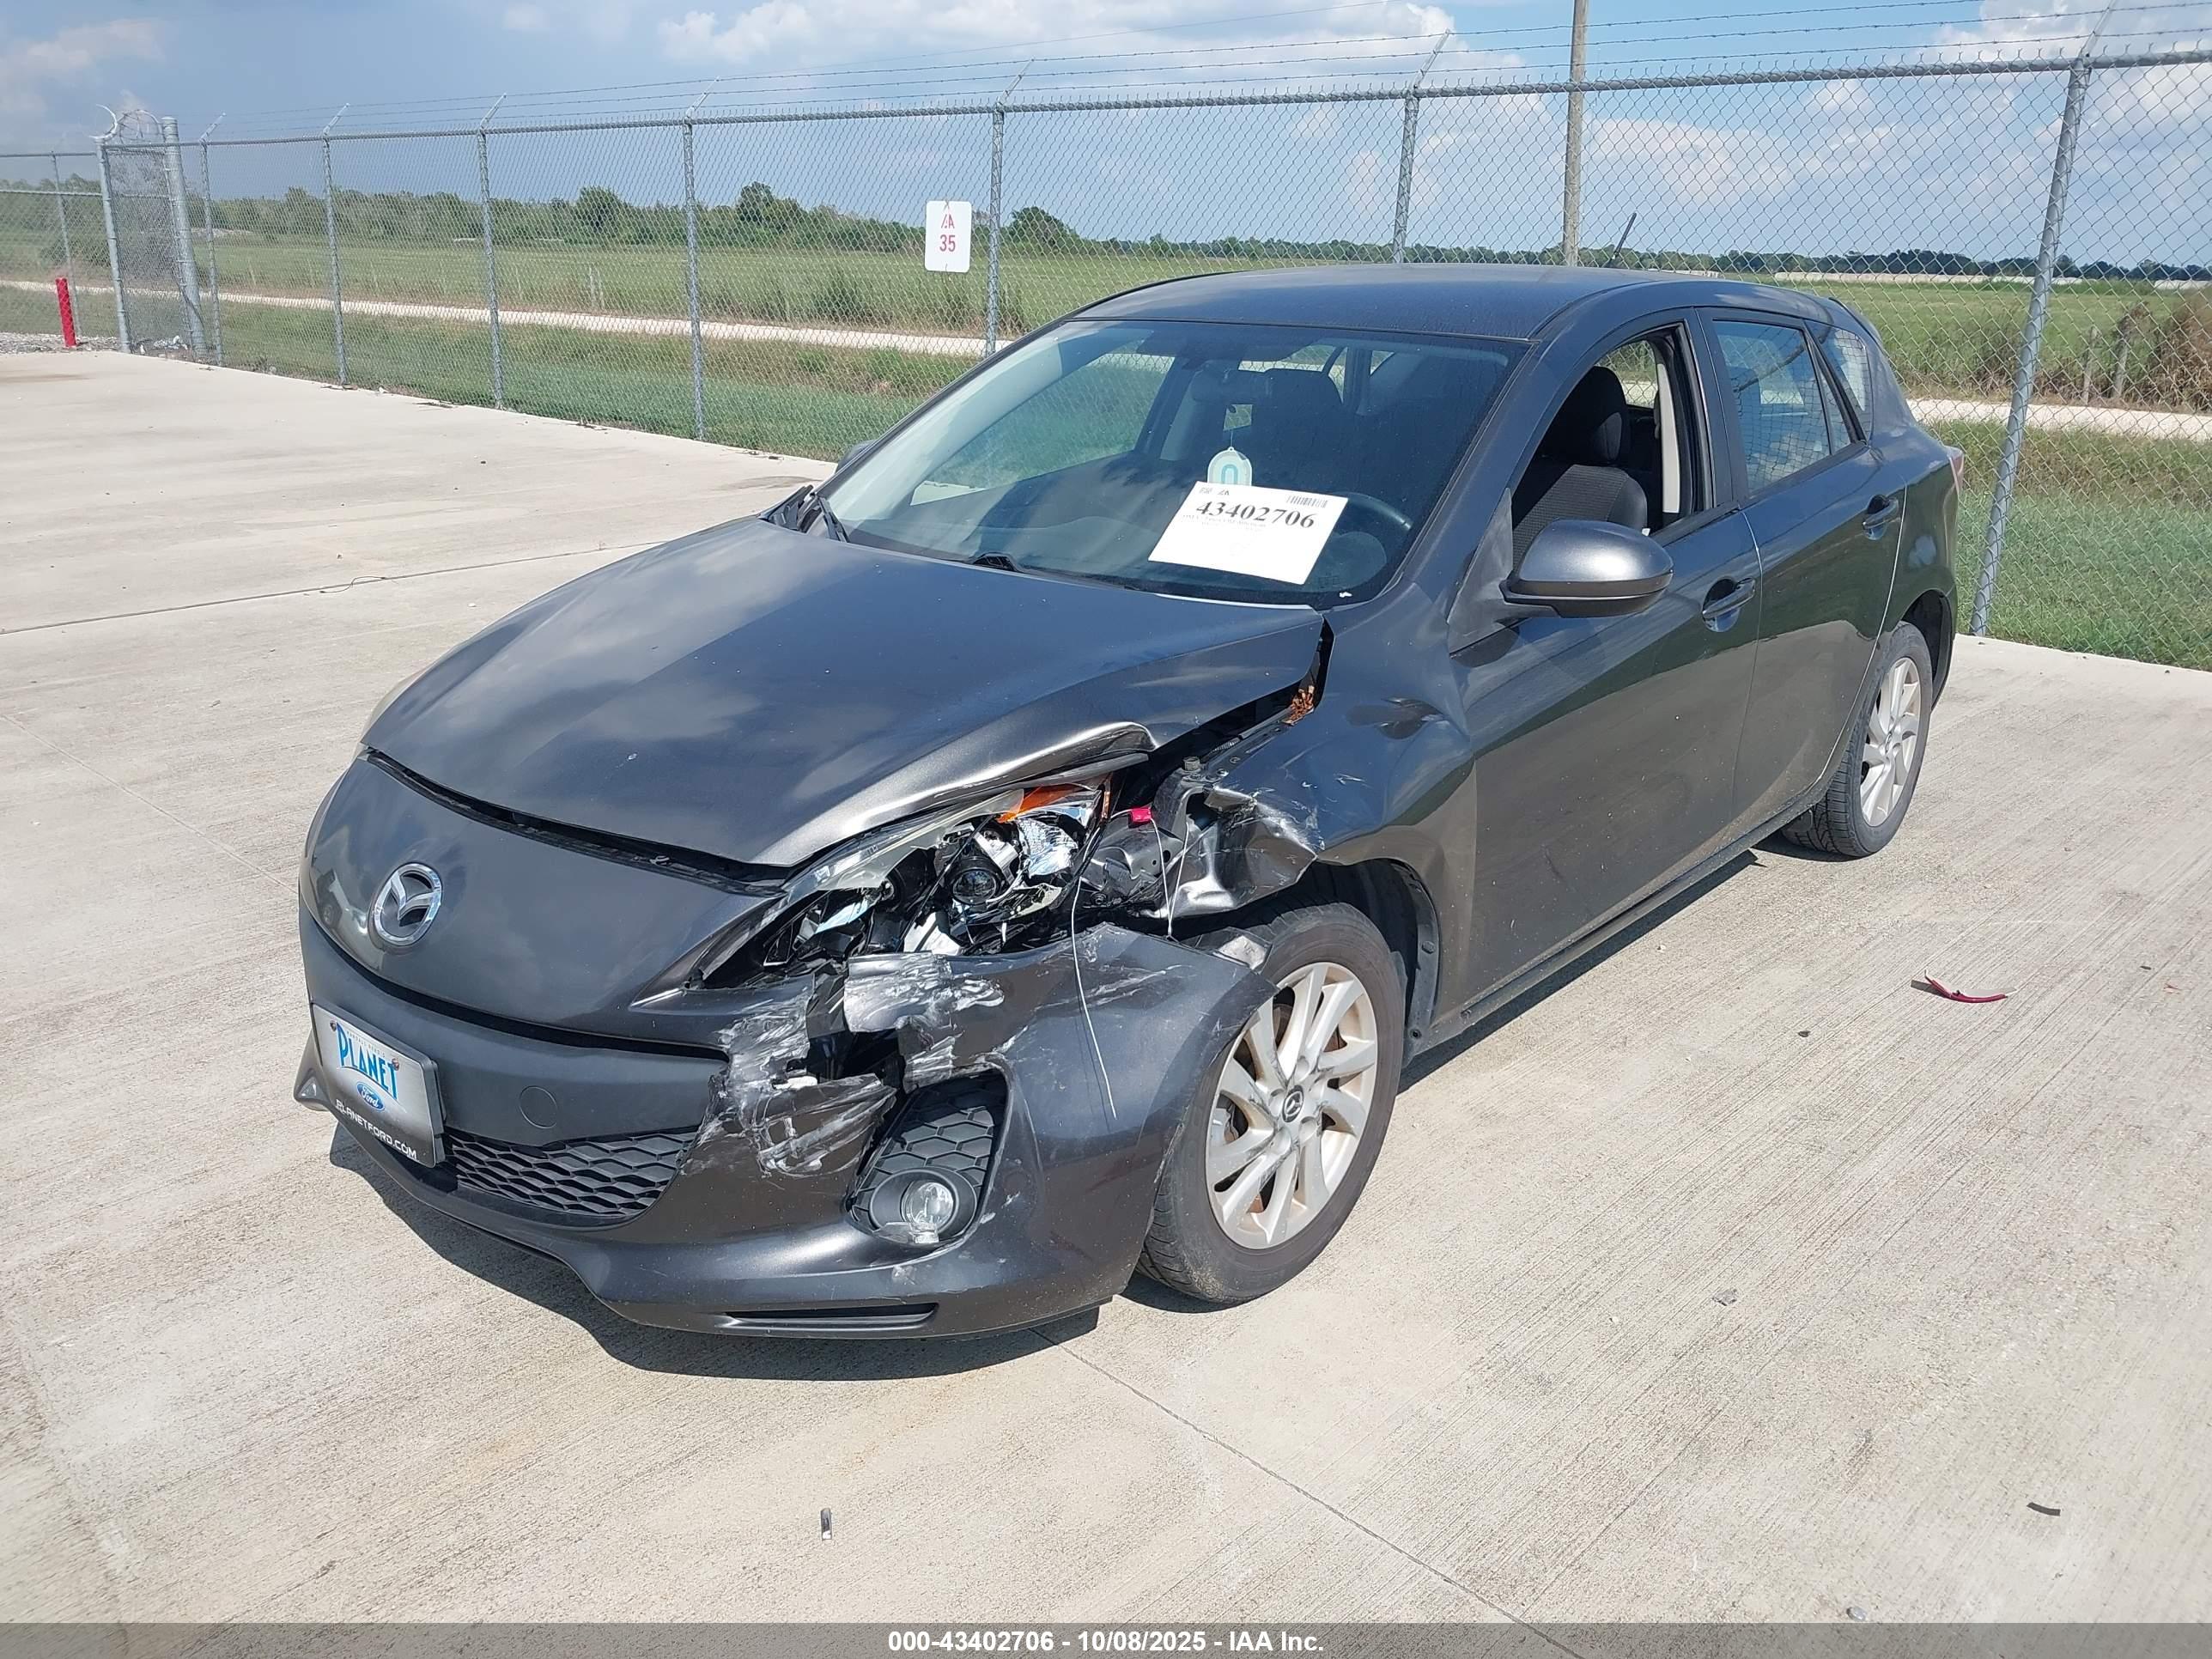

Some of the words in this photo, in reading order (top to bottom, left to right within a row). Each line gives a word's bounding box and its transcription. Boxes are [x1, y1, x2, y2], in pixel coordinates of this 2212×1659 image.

[939, 234, 956, 252] 35
[1196, 501, 1317, 529] 43402706
[336, 1022, 399, 1101] PLANET
[336, 1099, 417, 1159] PLANETFORD.COM
